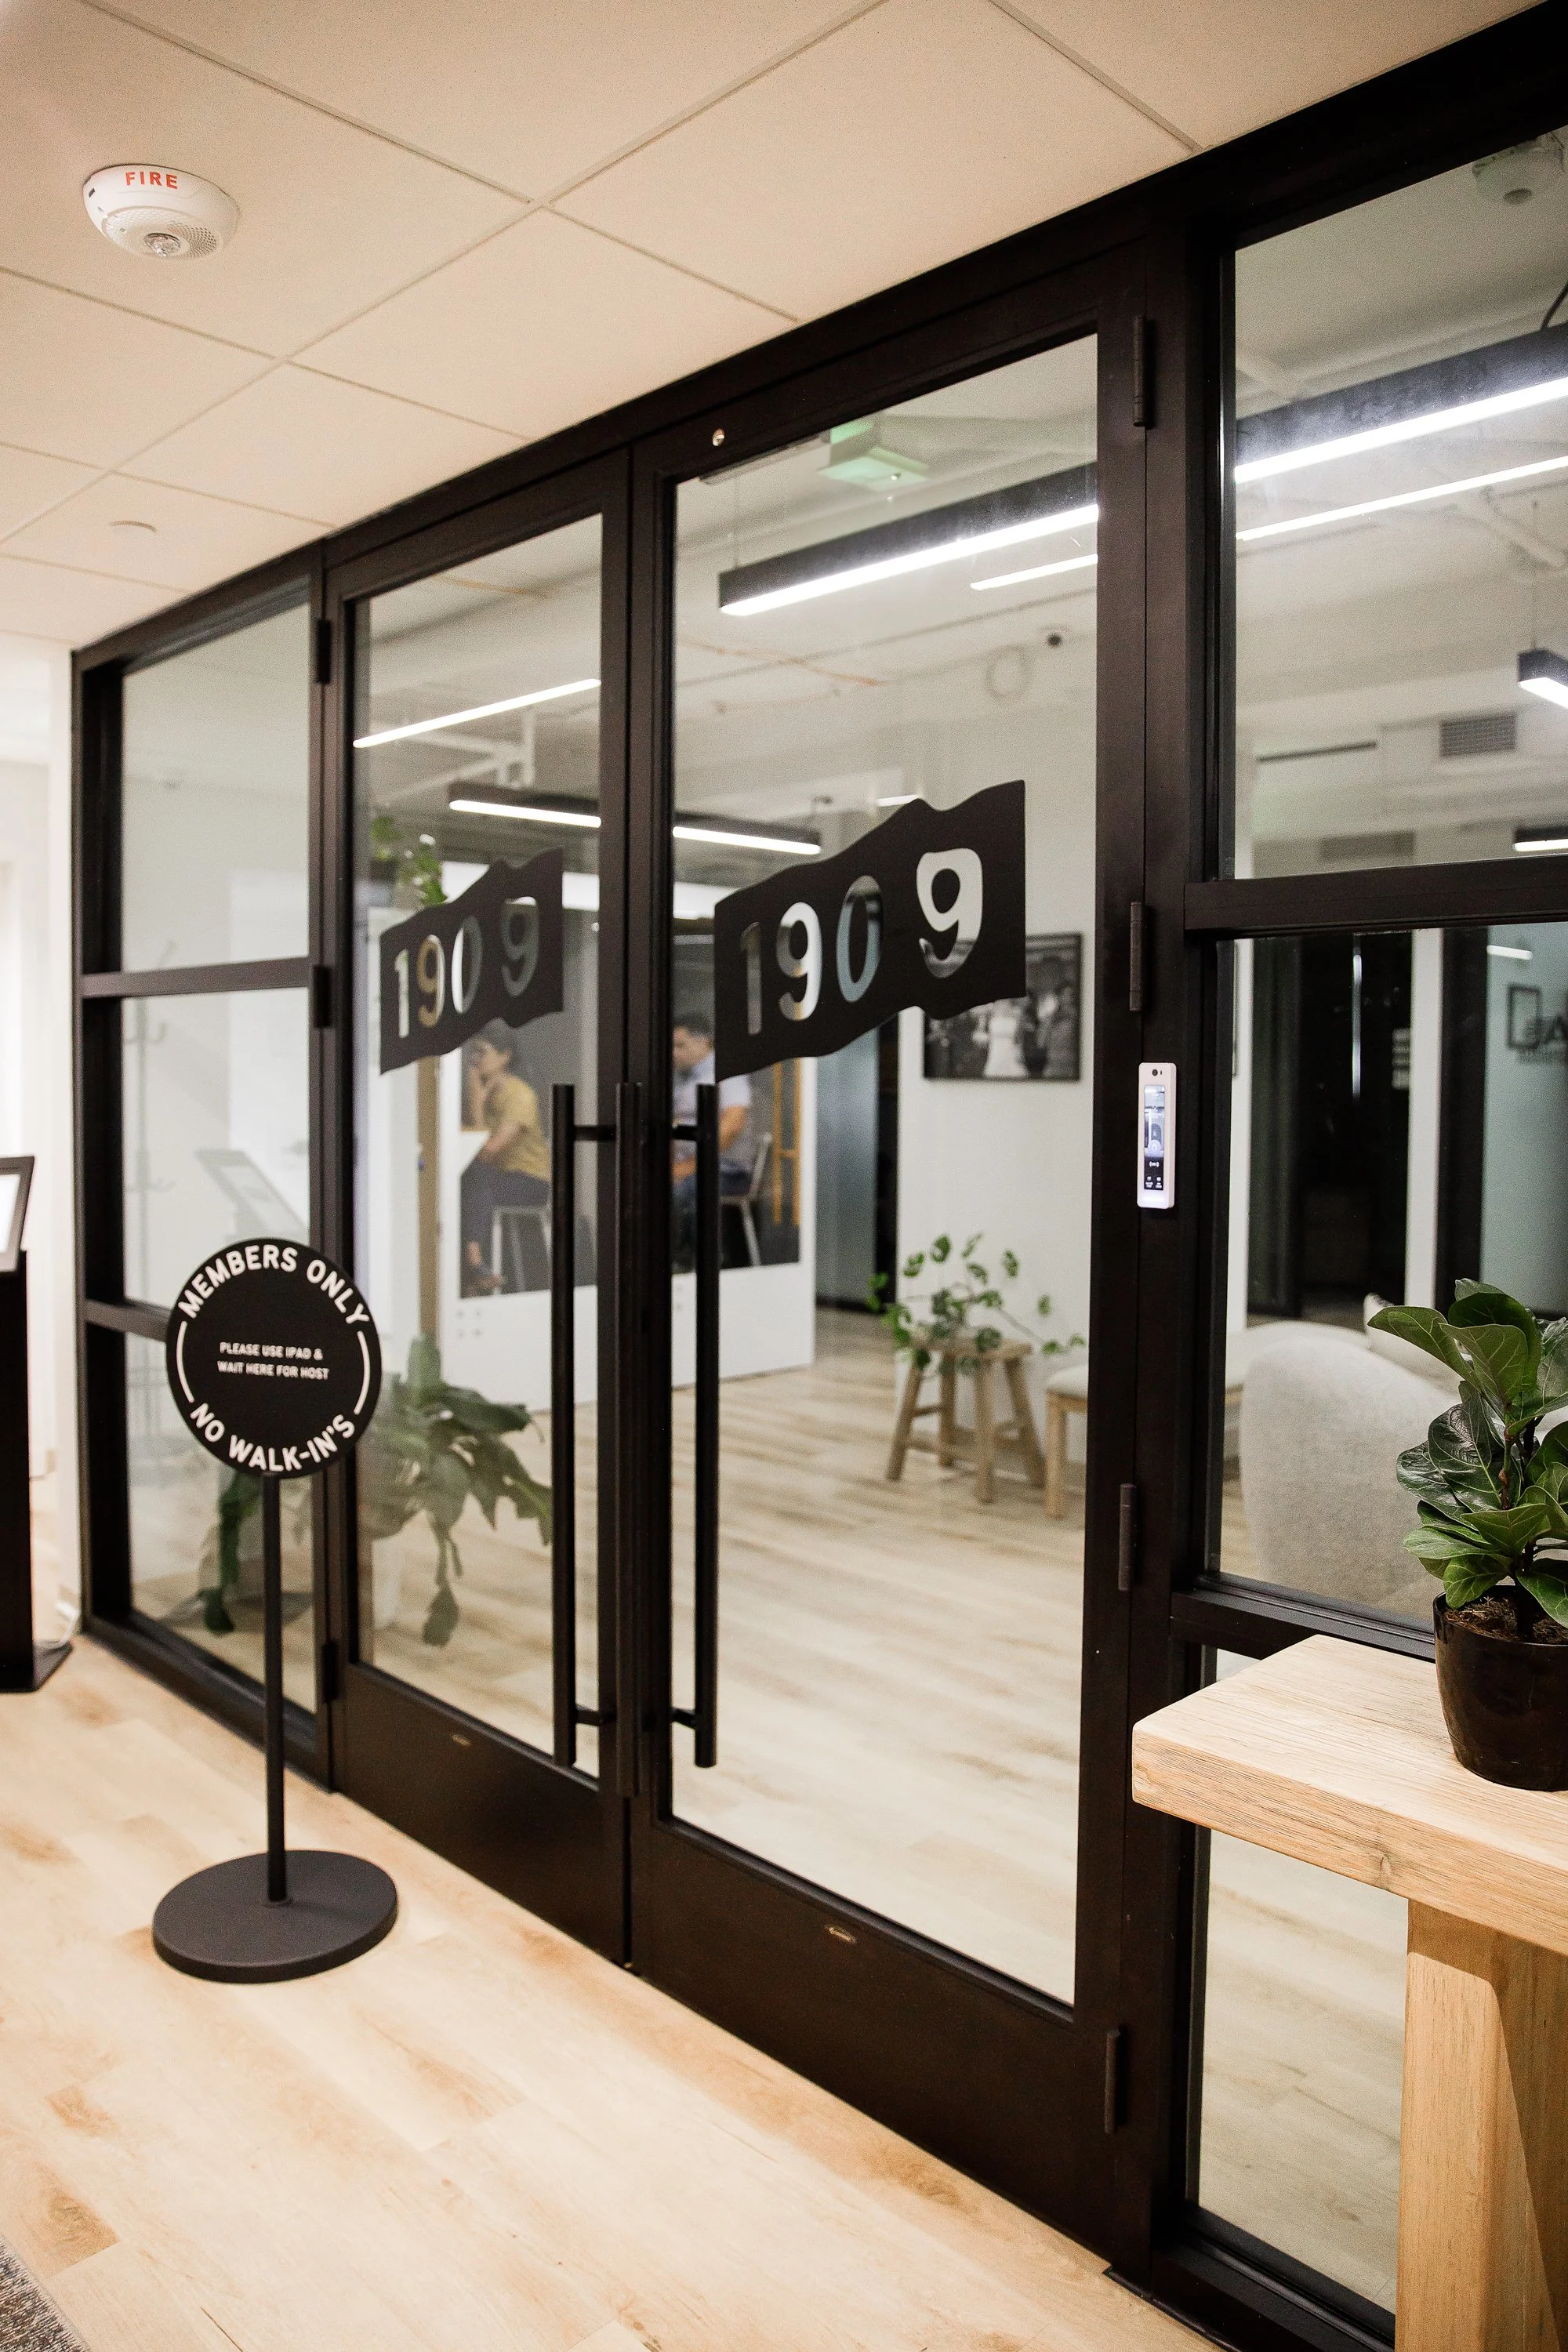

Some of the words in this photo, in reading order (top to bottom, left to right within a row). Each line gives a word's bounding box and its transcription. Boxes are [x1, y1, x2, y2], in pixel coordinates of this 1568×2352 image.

[125, 171, 178, 190] FIRE
[394, 896, 539, 1037] 1909
[739, 848, 984, 1037] 1909
[178, 1244, 298, 1319] MEMBERS
[307, 1259, 370, 1324] ONLY
[216, 1360, 245, 1374] WAIT
[245, 1363, 275, 1377] HERE
[276, 1364, 299, 1378] FOR
[299, 1367, 330, 1380] HOST
[220, 1341, 260, 1356] PLEASE
[261, 1345, 284, 1358] USE
[285, 1346, 312, 1360] IPAD
[313, 1348, 324, 1361] &
[190, 1403, 225, 1443] NO
[229, 1414, 355, 1472] WALK-IN'S
